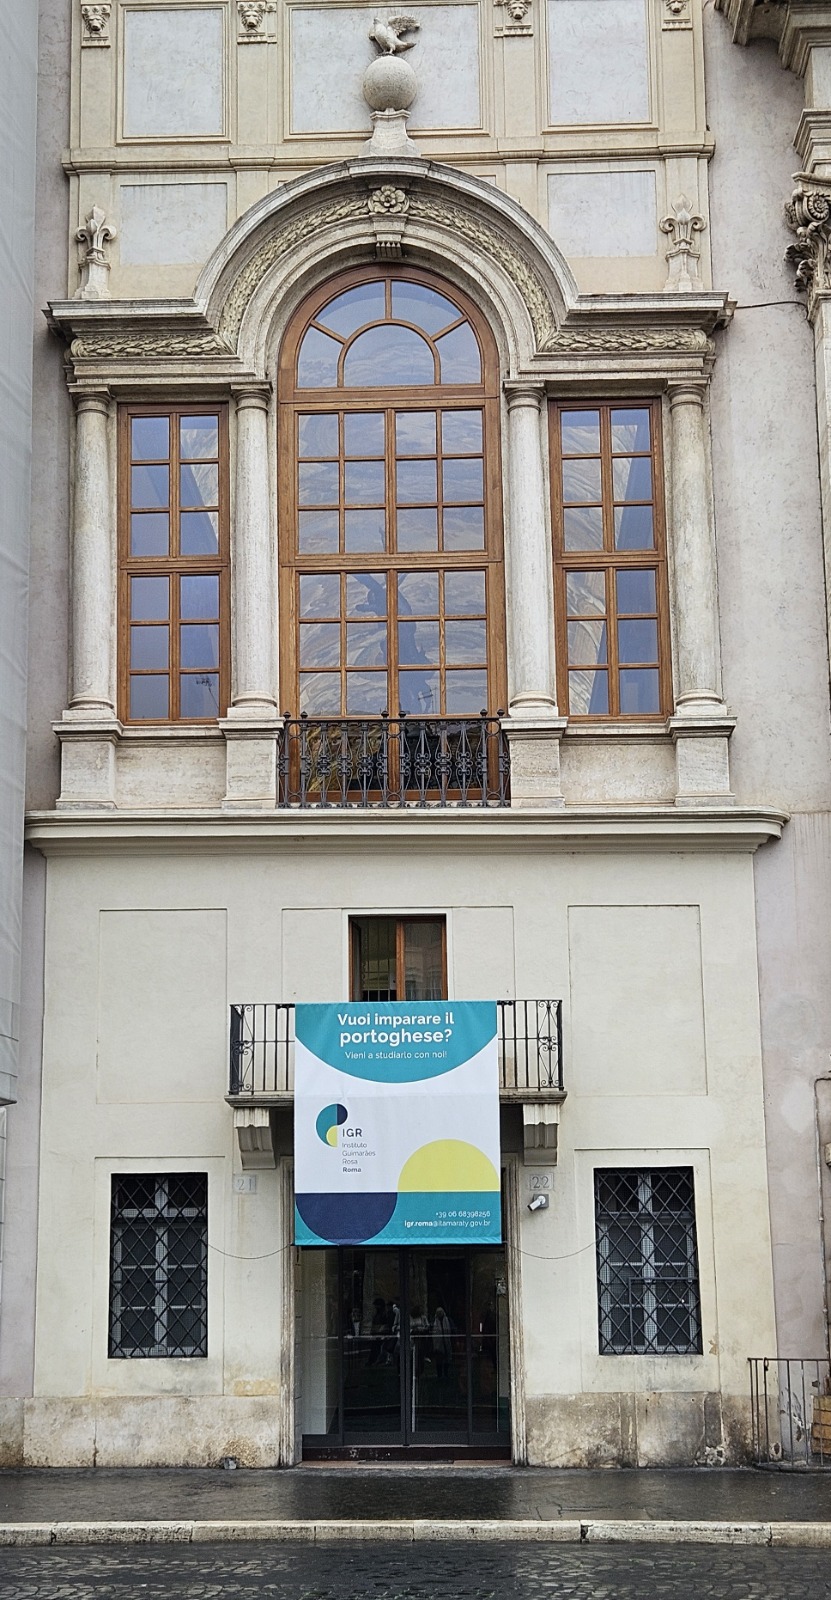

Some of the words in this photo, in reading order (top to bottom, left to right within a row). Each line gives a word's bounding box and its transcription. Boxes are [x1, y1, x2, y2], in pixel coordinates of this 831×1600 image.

[337, 1012, 371, 1026] Vuoi
[374, 1012, 441, 1028] imparare
[445, 1011, 455, 1024] il
[340, 1028, 453, 1047] portoghese?
[344, 1051, 366, 1060] Vieni
[375, 1051, 412, 1060] studiarlo
[414, 1051, 430, 1059] con
[432, 1050, 448, 1059] noi!
[342, 1128, 363, 1138] IGR
[237, 1178, 252, 1191] 21
[531, 1175, 550, 1189] 22
